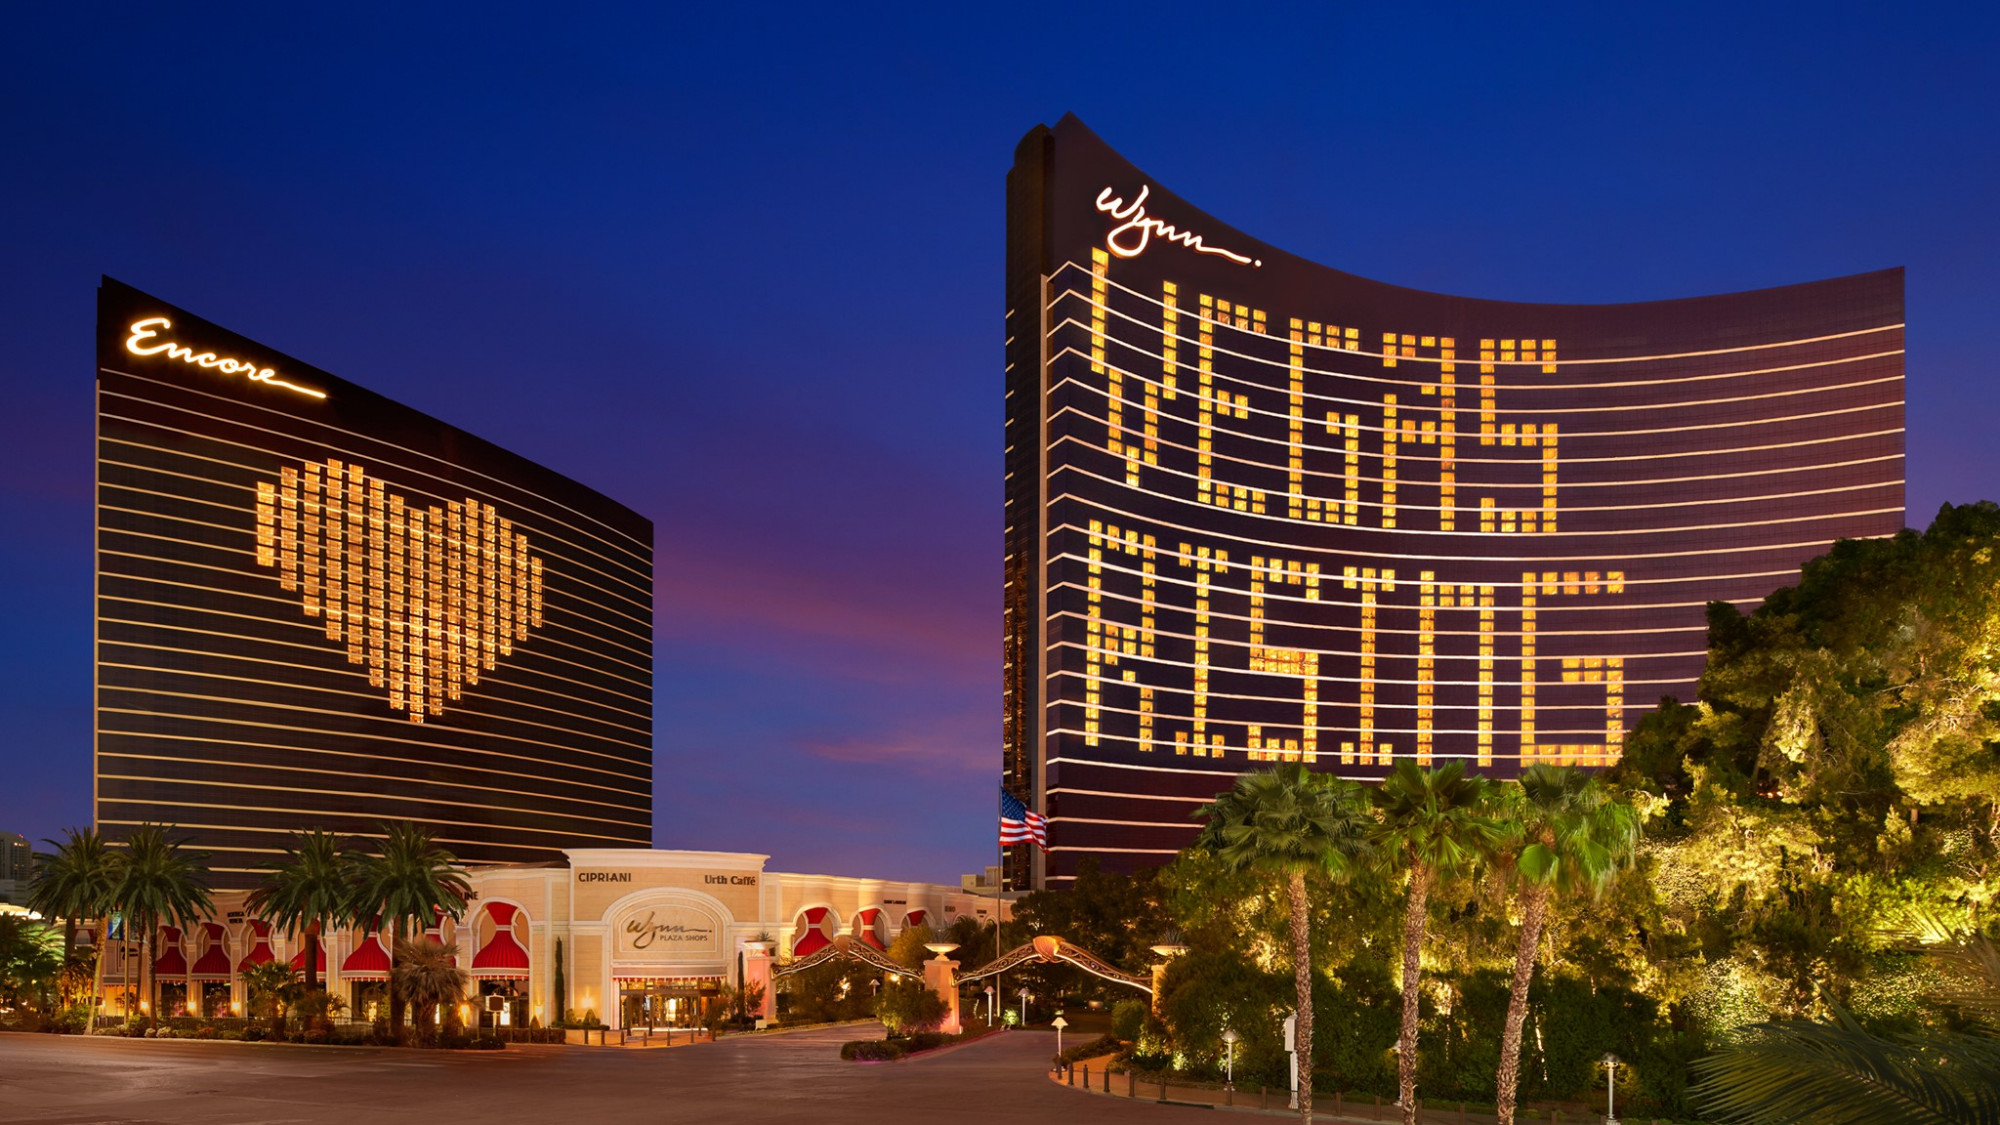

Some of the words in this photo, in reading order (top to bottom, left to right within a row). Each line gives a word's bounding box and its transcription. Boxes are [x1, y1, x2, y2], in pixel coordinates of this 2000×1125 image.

[126, 317, 327, 399] Encore
[1090, 246, 1559, 534] VEGAS
[1084, 518, 1626, 767] RISING
[578, 872, 632, 883] CIPRIANI
[704, 874, 728, 885] Urth
[730, 875, 756, 886] Caffé
[659, 934, 683, 942] PLAZA
[685, 934, 708, 942] SHOPS
